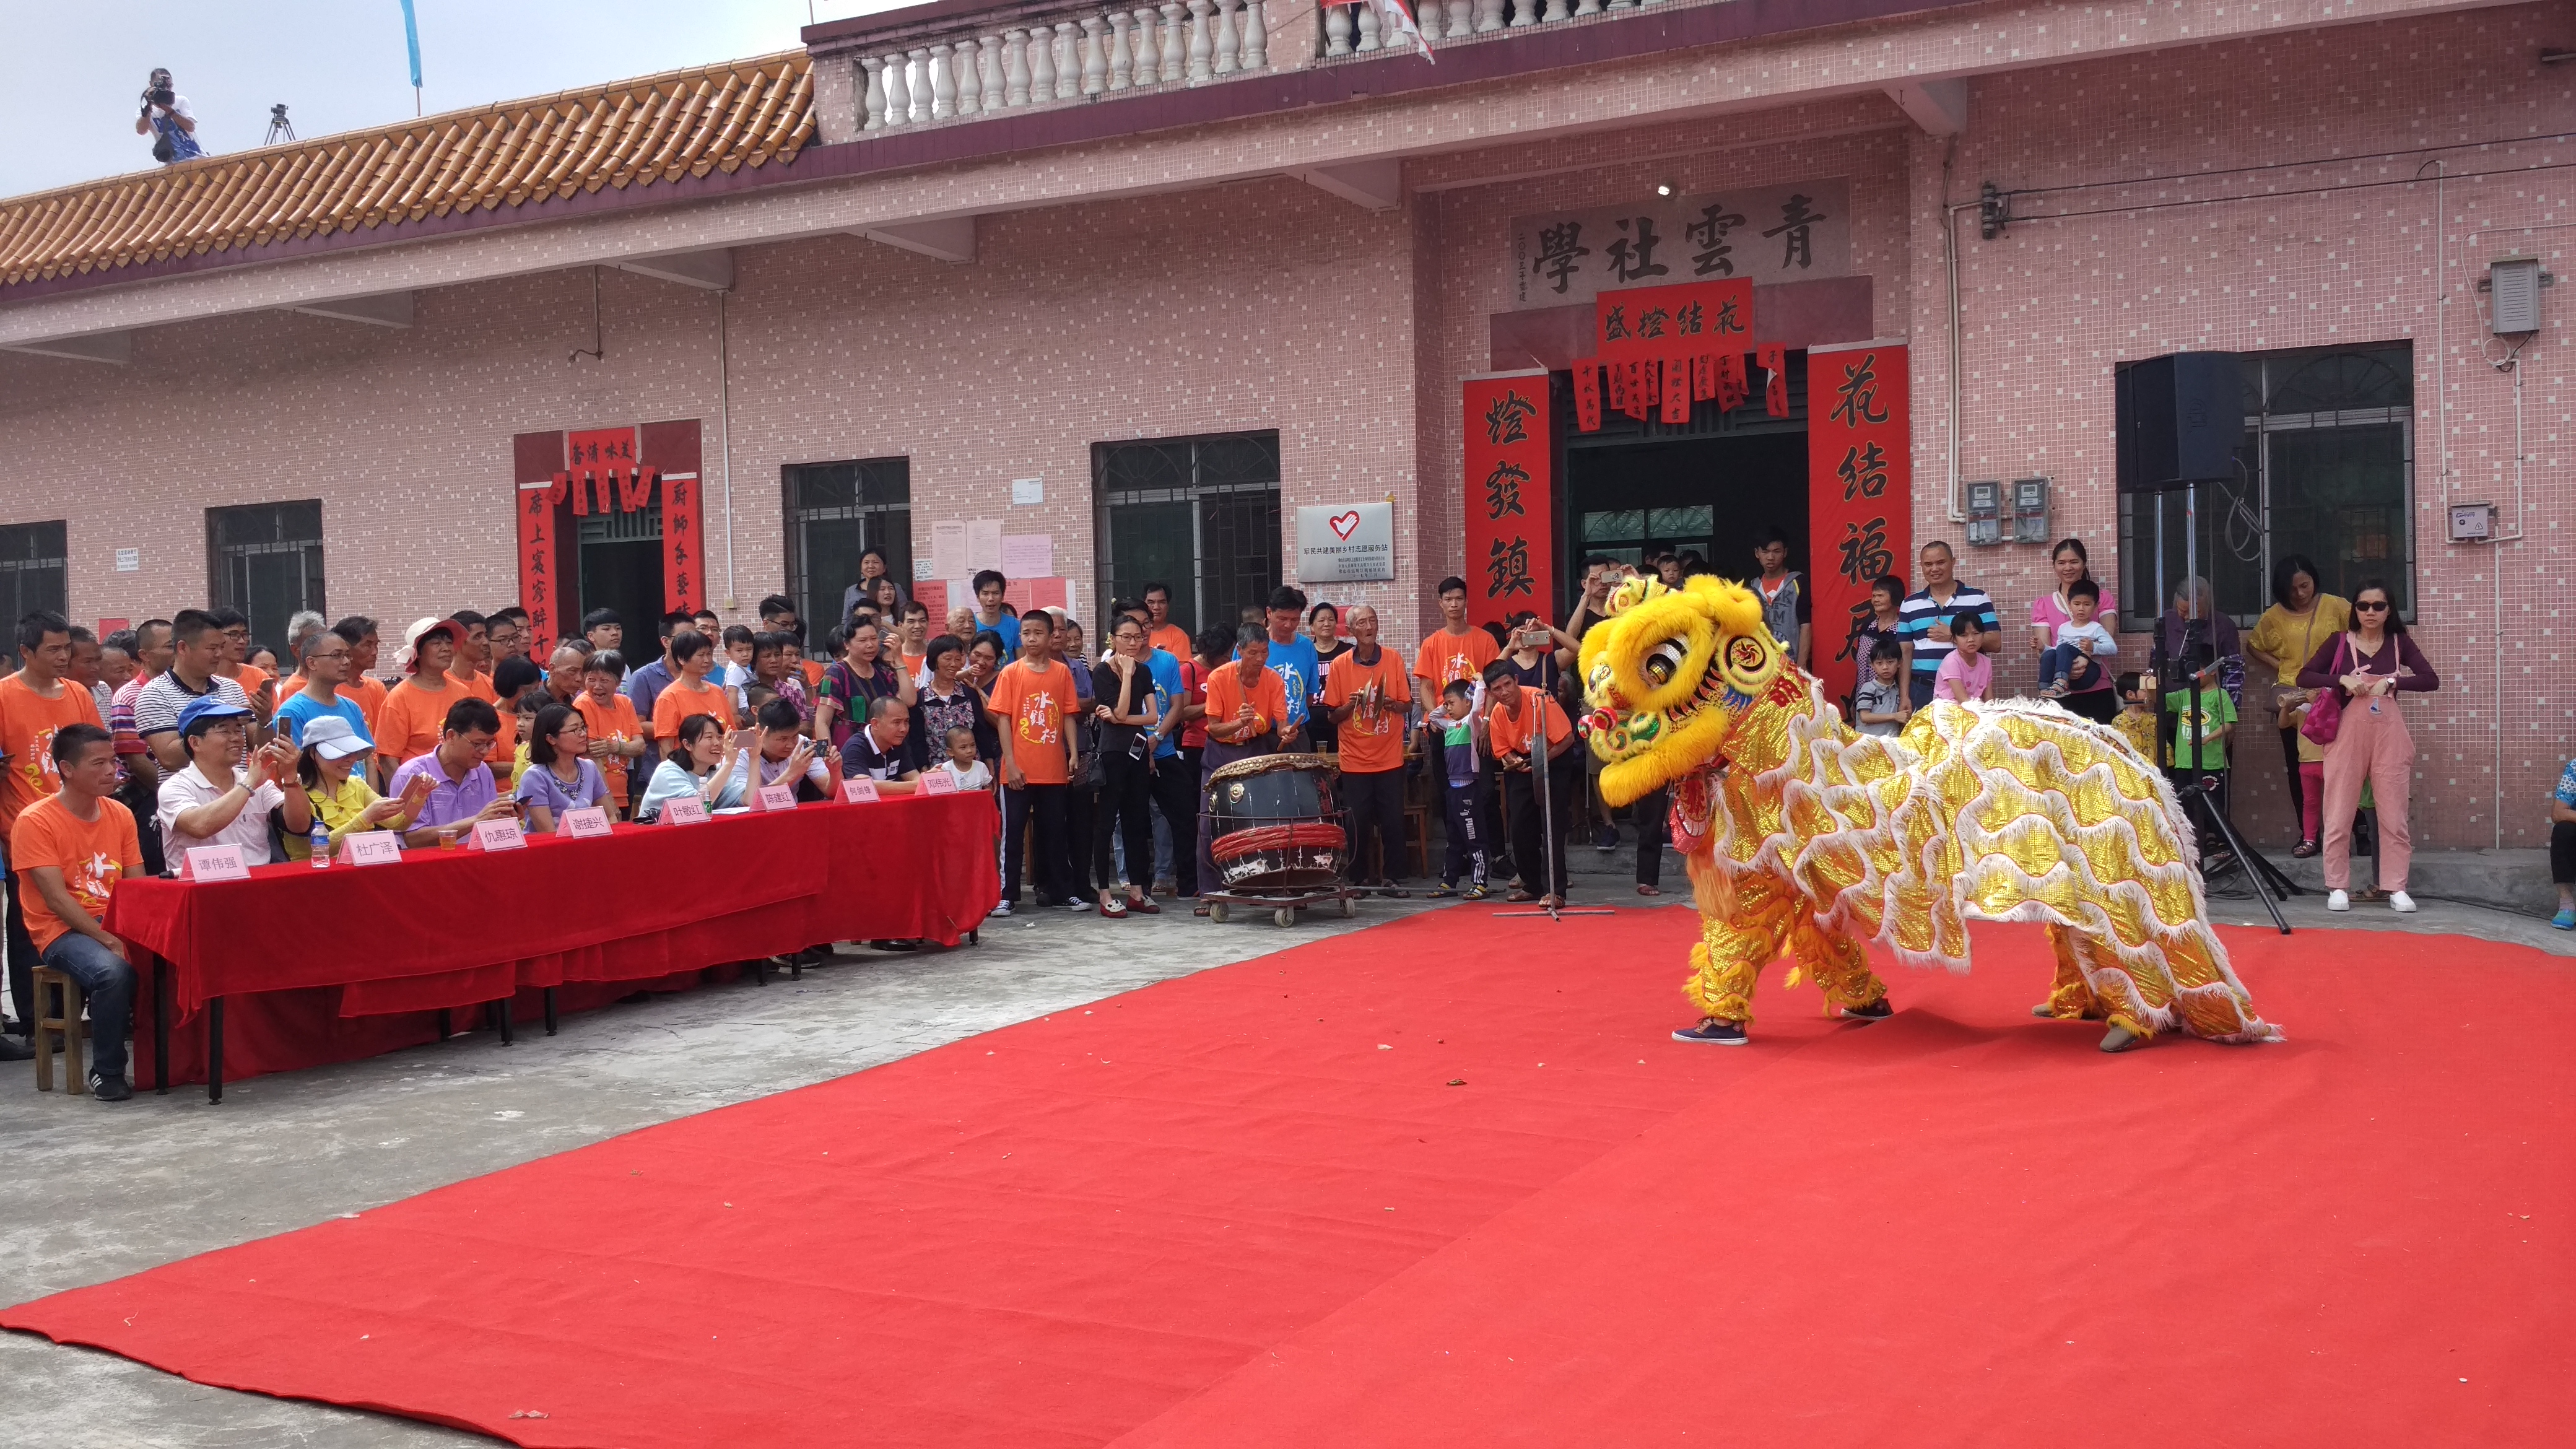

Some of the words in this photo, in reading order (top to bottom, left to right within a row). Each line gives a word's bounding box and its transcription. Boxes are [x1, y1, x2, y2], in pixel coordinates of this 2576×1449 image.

[1303, 544, 1388, 555] 军民共建美丽乡村志愿服务站
[928, 777, 952, 788] 邓伟光
[765, 791, 791, 804] 陈建红
[673, 804, 702, 817] 叶敏红
[572, 816, 605, 830] 谢捷兴
[484, 827, 518, 843] 仇惠琼
[356, 842, 394, 856] 杜广泽
[198, 856, 238, 871] 谭伟强
